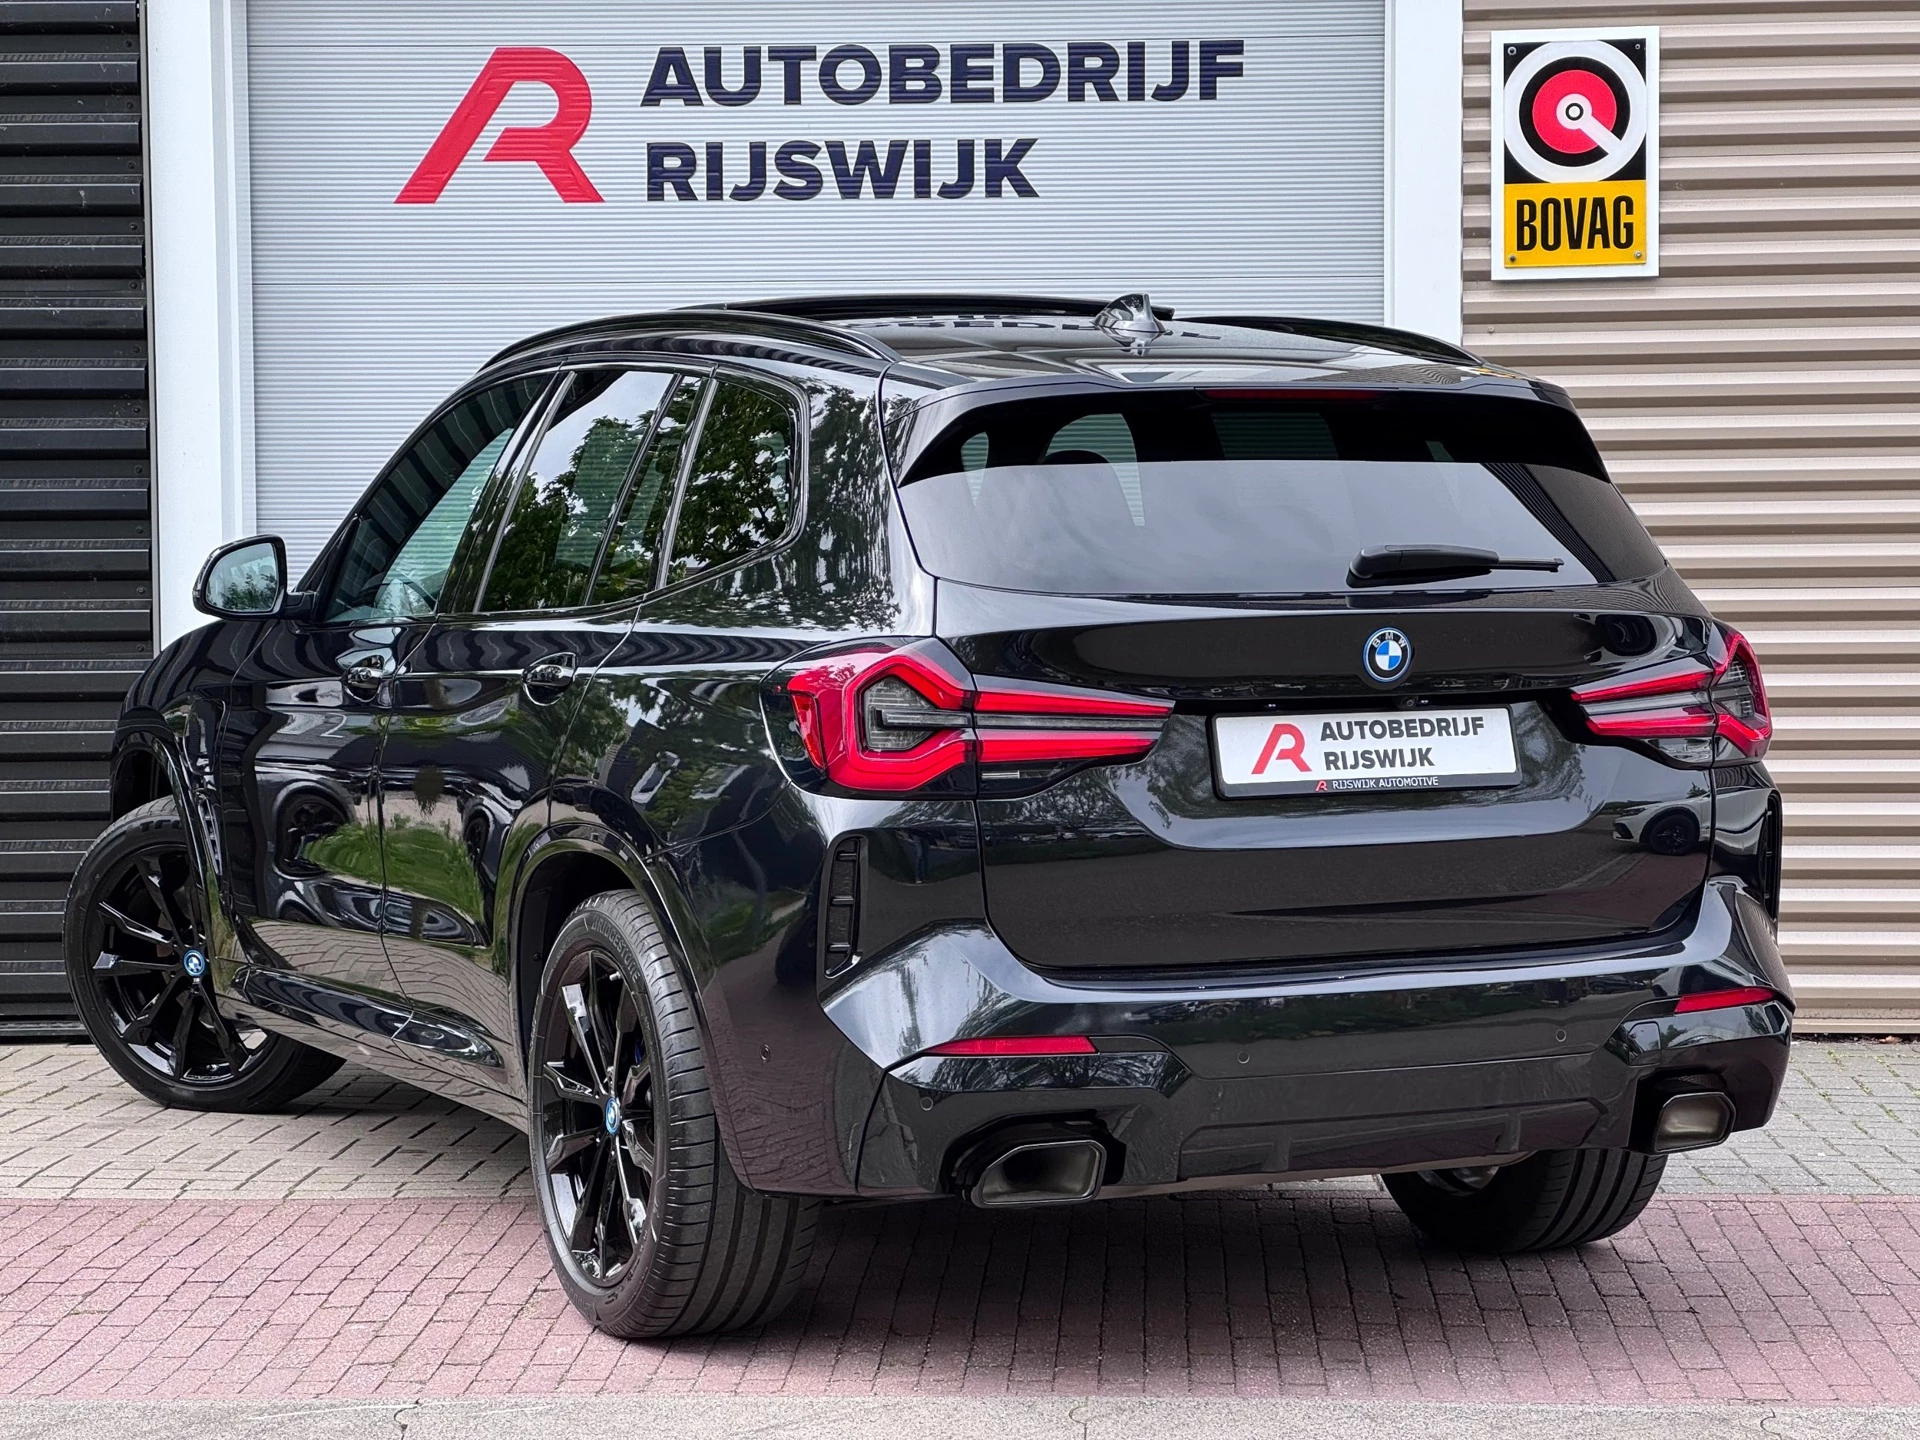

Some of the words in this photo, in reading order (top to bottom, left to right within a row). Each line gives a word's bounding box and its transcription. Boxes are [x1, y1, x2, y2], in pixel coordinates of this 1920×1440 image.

[641, 39, 1244, 107] AUTOBEDRIJF
[646, 137, 1039, 201] RIJSWIJK
[1515, 195, 1634, 251] BOVAG
[1372, 632, 1407, 648] BMW
[1320, 717, 1485, 741] AUTOBEDRIJF
[1323, 747, 1435, 770] RIJSWIJK
[1332, 779, 1377, 790] RIJSWIJK
[1379, 776, 1439, 788] AUTOMOTIVE
